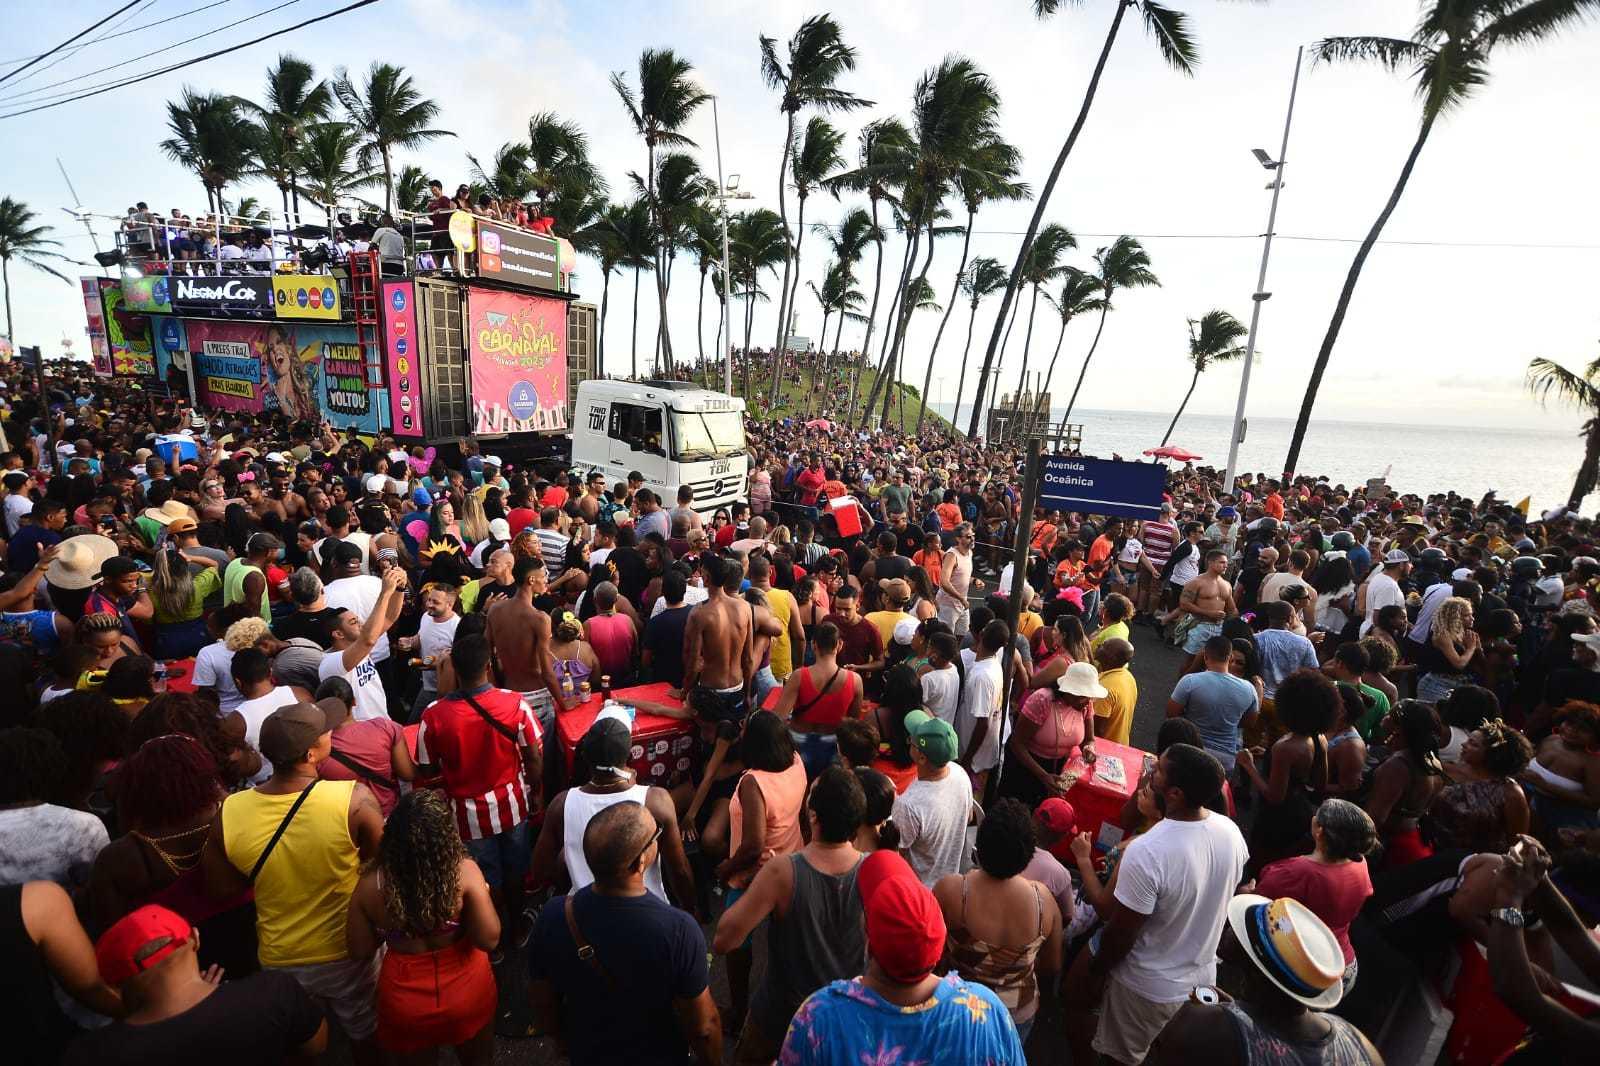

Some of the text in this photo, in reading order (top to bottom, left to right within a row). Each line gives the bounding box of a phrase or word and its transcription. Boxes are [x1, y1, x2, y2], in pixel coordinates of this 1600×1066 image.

[480, 322, 558, 356] CARNAVAL
[324, 344, 361, 361] O MELHO
[325, 360, 362, 376] CARNAVA
[326, 375, 363, 392] DO MUND
[330, 391, 365, 408] VOLTOU
[590, 405, 607, 415] TRIO
[588, 412, 607, 431] TOK
[709, 463, 731, 476] TOK
[1046, 460, 1085, 471] Avenida
[1044, 473, 1094, 487] Oceânica
